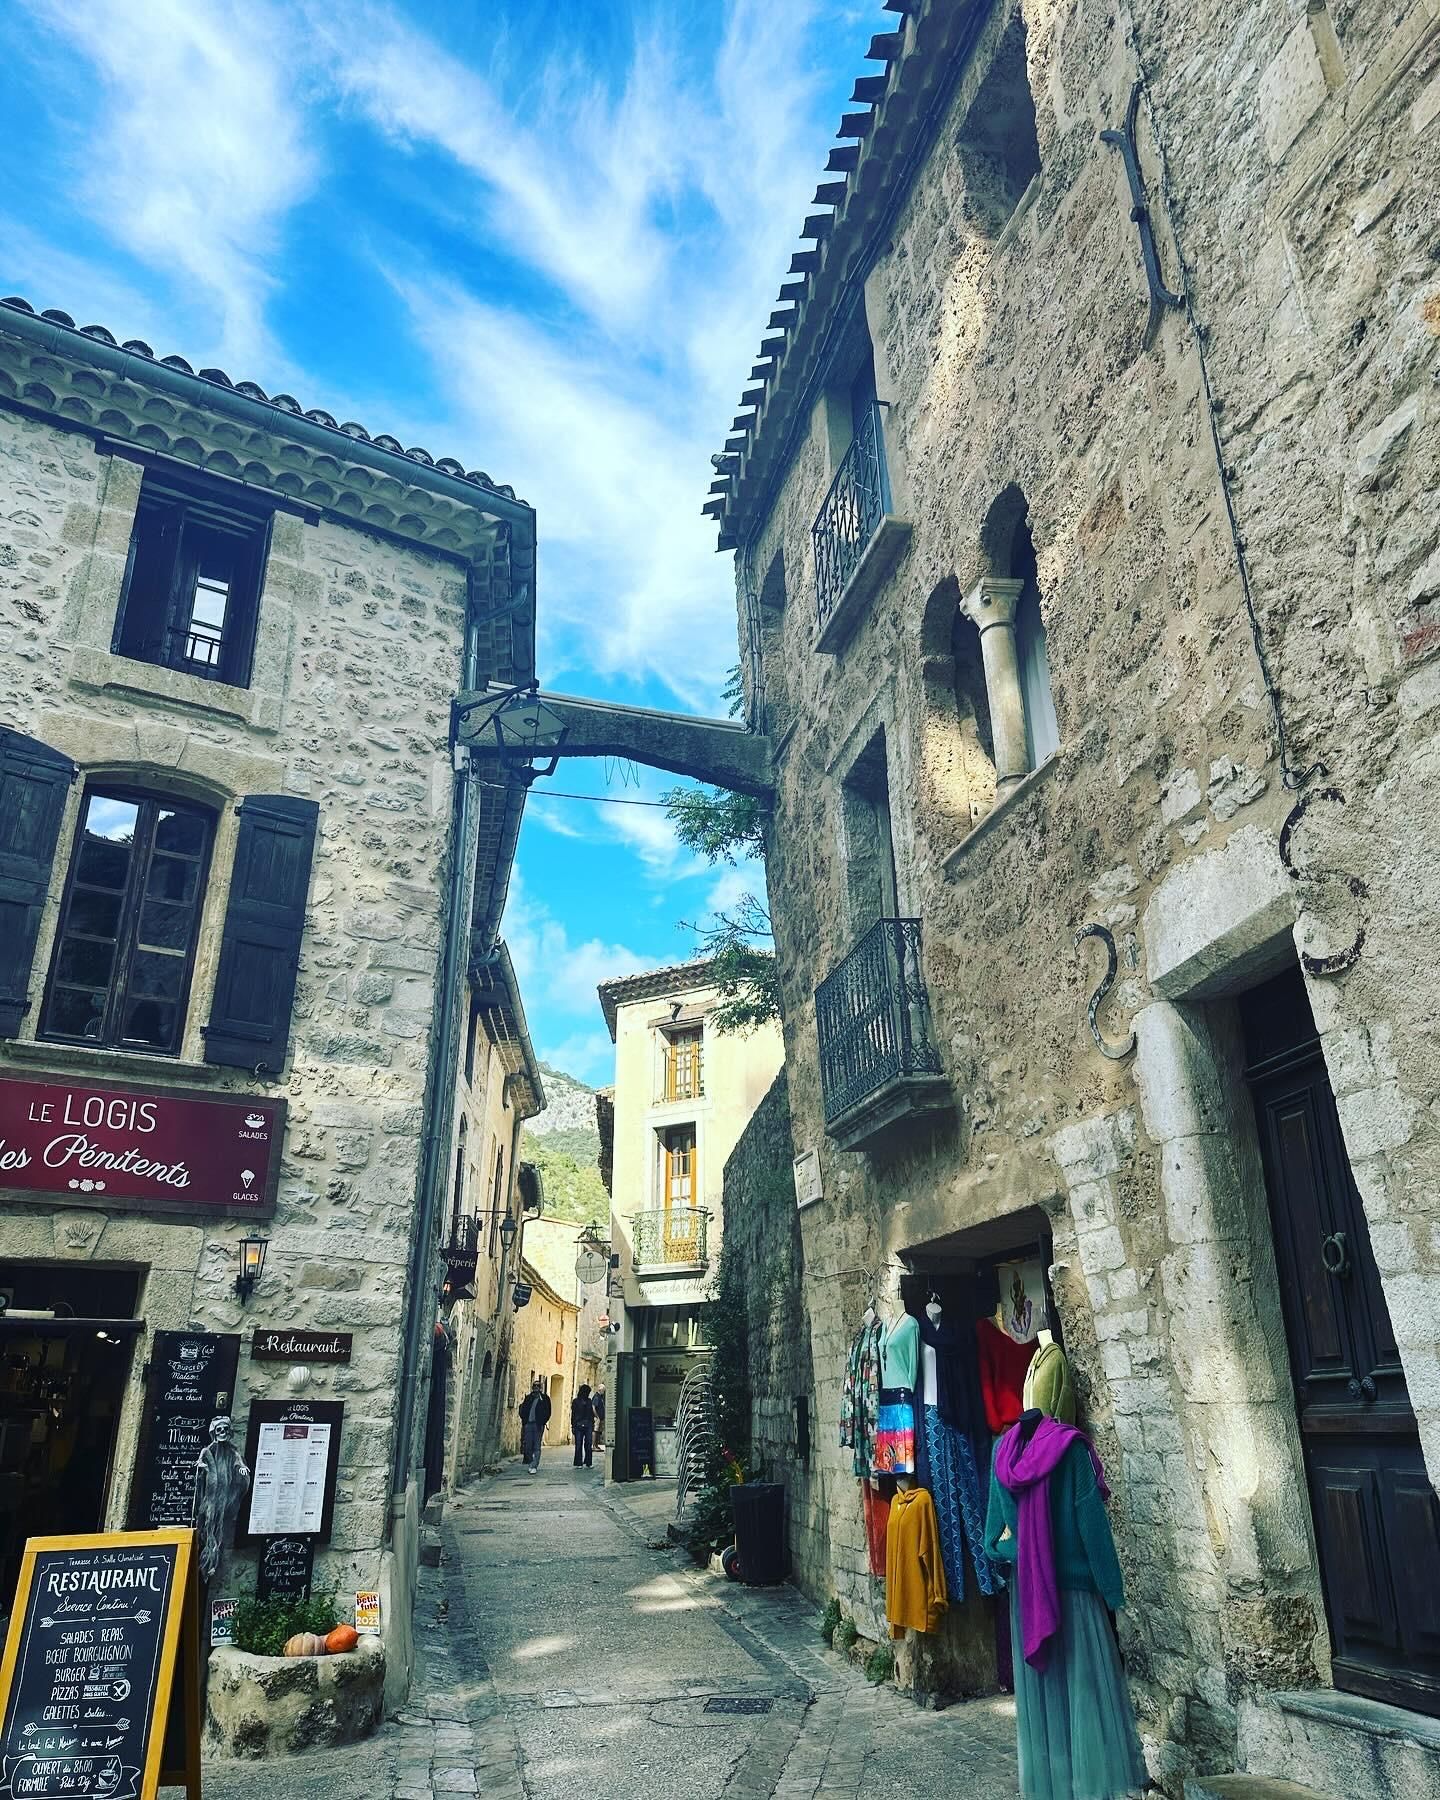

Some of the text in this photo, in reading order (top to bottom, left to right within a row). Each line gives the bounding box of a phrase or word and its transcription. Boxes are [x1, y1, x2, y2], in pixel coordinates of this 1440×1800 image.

[29, 1094, 158, 1133] LE LOGIS
[238, 1130, 268, 1141] SALADES
[0, 1134, 191, 1189] es Pénitents
[233, 1192, 259, 1202] GLACES
[442, 1256, 475, 1269] rêperie
[260, 1335, 346, 1354] Restaurant
[168, 1428, 201, 1443] Menu
[101, 1554, 116, 1564] Salle
[47, 1567, 161, 1597] RESTAURANT
[53, 1595, 93, 1615] Service
[357, 1595, 377, 1606] petit
[60, 1627, 124, 1645] SALADES REPAS
[212, 1626, 232, 1636] 202
[54, 1666, 86, 1683] BURGER
[51, 1685, 80, 1701] PIZZAS
[43, 1704, 80, 1721] GALETTES
[18, 1740, 26, 1751] Le
[32, 1760, 62, 1775] OUVERT
[73, 1760, 93, 1774] 8h00
[17, 1776, 50, 1793] FORMULE
